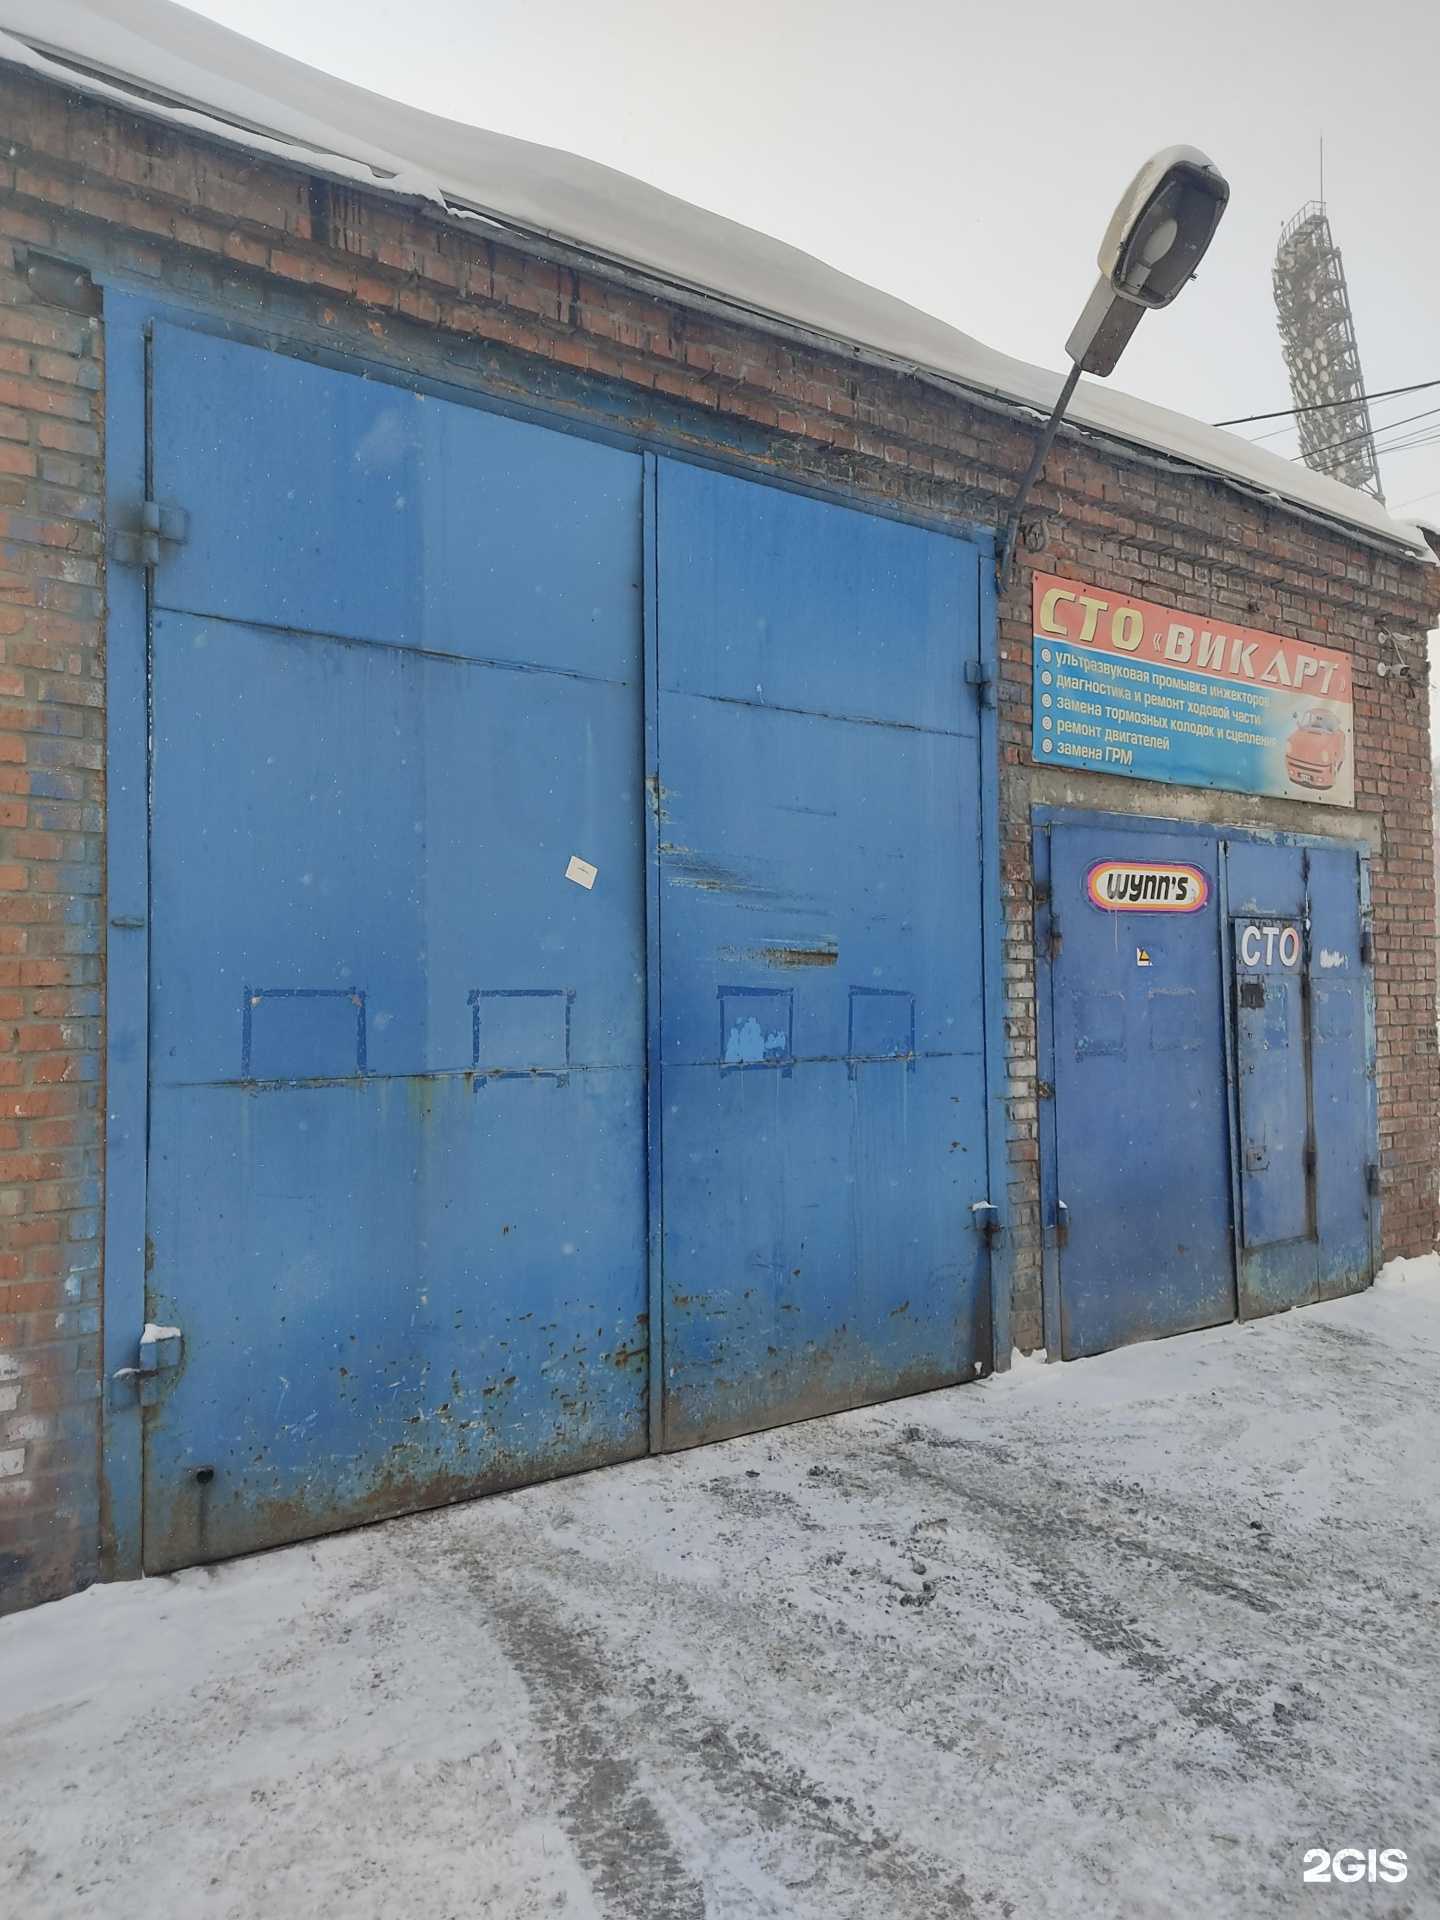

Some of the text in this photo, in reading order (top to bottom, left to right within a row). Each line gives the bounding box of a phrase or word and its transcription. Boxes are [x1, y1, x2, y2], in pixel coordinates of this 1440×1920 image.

[1039, 588, 1144, 651] СТО
[1056, 651, 1149, 683] ультразвуковая
[1152, 673, 1208, 695] промывка
[1056, 674, 1131, 701] диагностика
[1134, 691, 1142, 703] и
[1144, 692, 1185, 711] ремонт
[1187, 701, 1230, 719] ходовой
[1056, 696, 1102, 717] замена
[1104, 706, 1168, 729] тормозных
[1170, 719, 1215, 738] колодок
[1216, 727, 1224, 740] и
[1056, 719, 1170, 750] ремонт двигателей
[1056, 742, 1133, 766] замена ГРМ
[1241, 925, 1299, 967] СТО
